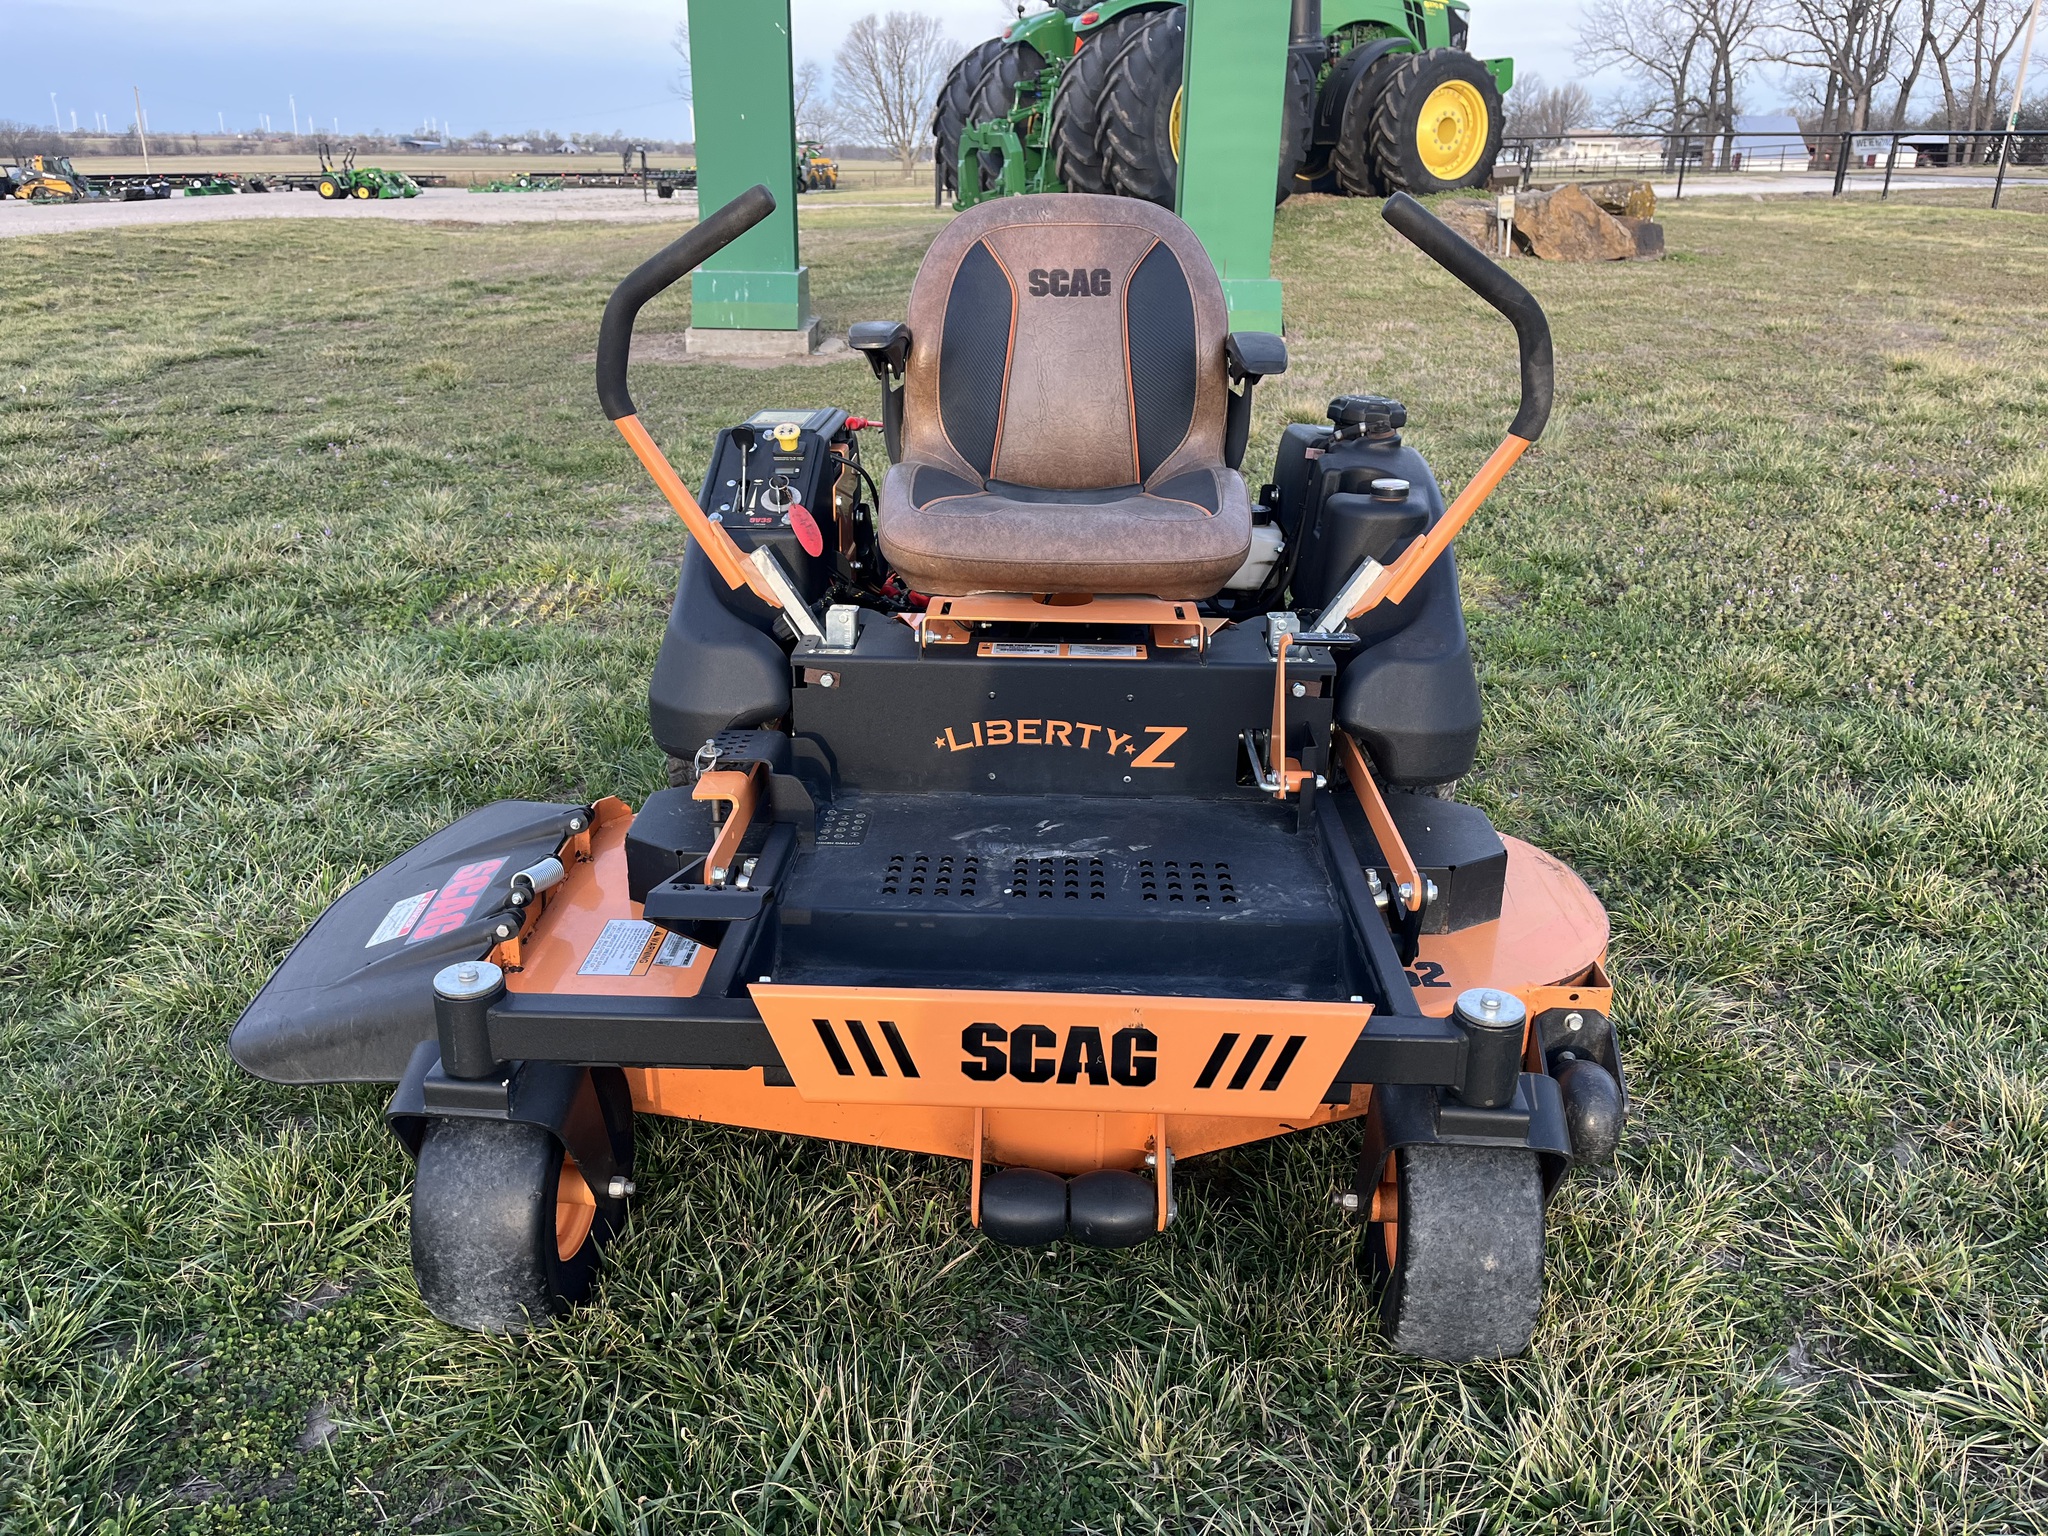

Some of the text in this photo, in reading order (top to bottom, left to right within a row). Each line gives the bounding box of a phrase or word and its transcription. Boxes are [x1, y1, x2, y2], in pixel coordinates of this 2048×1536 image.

[1029, 268, 1111, 297] SCAG
[944, 718, 1188, 768] LIBERTY Z
[412, 859, 503, 940] SCAG
[961, 1022, 1158, 1087] SCAG
